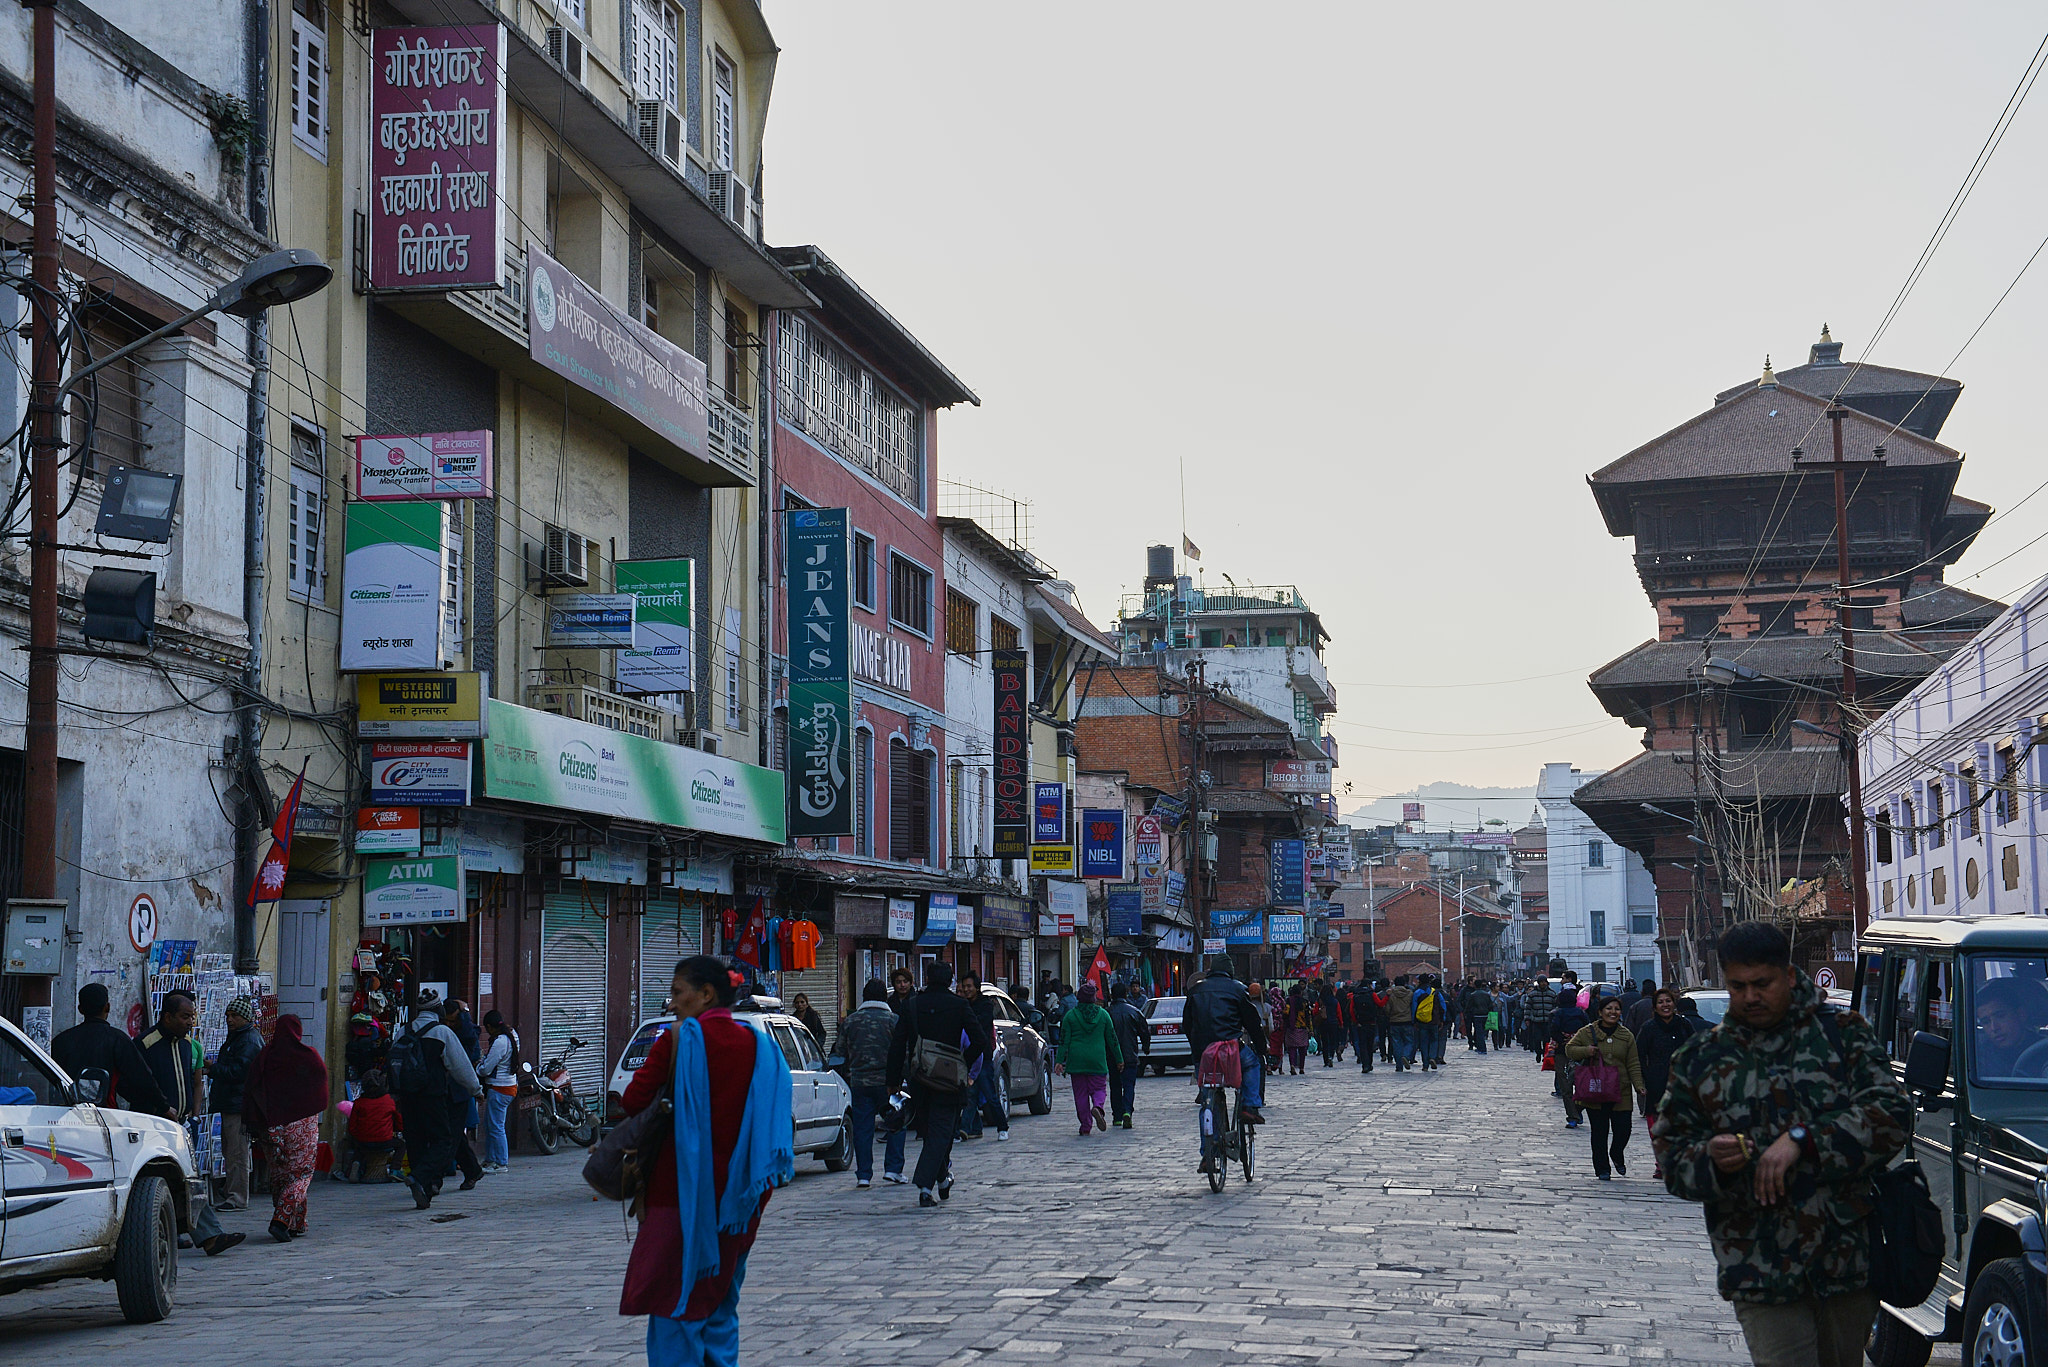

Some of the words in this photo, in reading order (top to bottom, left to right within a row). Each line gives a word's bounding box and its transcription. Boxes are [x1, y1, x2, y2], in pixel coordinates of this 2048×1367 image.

[385, 32, 486, 88] गौरीशंकर
[380, 161, 442, 216] सहकारी
[446, 166, 489, 212] संस्था
[398, 222, 471, 277] लिमिटेड
[545, 342, 569, 369] Gauri
[362, 466, 429, 478] MoneyGram
[452, 464, 477, 472] REMIT
[379, 477, 402, 485] Money
[403, 476, 431, 484] Transfer
[350, 589, 391, 600] Citizens
[635, 590, 684, 608] शियाली
[803, 544, 834, 670] JEANS
[565, 613, 600, 622] Reliable
[602, 613, 629, 621] Remit
[362, 636, 390, 650] न्यूरोड
[391, 638, 414, 648] शाखा
[655, 646, 681, 656] Remit
[384, 682, 441, 691] WESTERN
[402, 691, 441, 699] UNION
[389, 704, 406, 715] मनी
[411, 706, 449, 717] ट्रान्सफर
[998, 673, 1021, 820] BANDBOX
[560, 751, 597, 780] Citizens
[601, 748, 615, 761] Bank
[800, 701, 846, 819] Carlsberg
[1273, 773, 1298, 782] BHOE
[692, 779, 721, 805] Citizens
[723, 776, 735, 787] Bank
[1038, 787, 1060, 797] ATM
[1038, 823, 1060, 833] NIBL
[359, 835, 388, 844] Citizens
[1088, 848, 1117, 862] NIBL
[388, 863, 434, 880] ATM
[1273, 842, 1283, 901] BHANUDAYA
[377, 892, 412, 902] Citizens
[1234, 925, 1261, 938] CHANGER
[1273, 923, 1300, 933] MONEY
[1271, 933, 1302, 942] CHANGER
